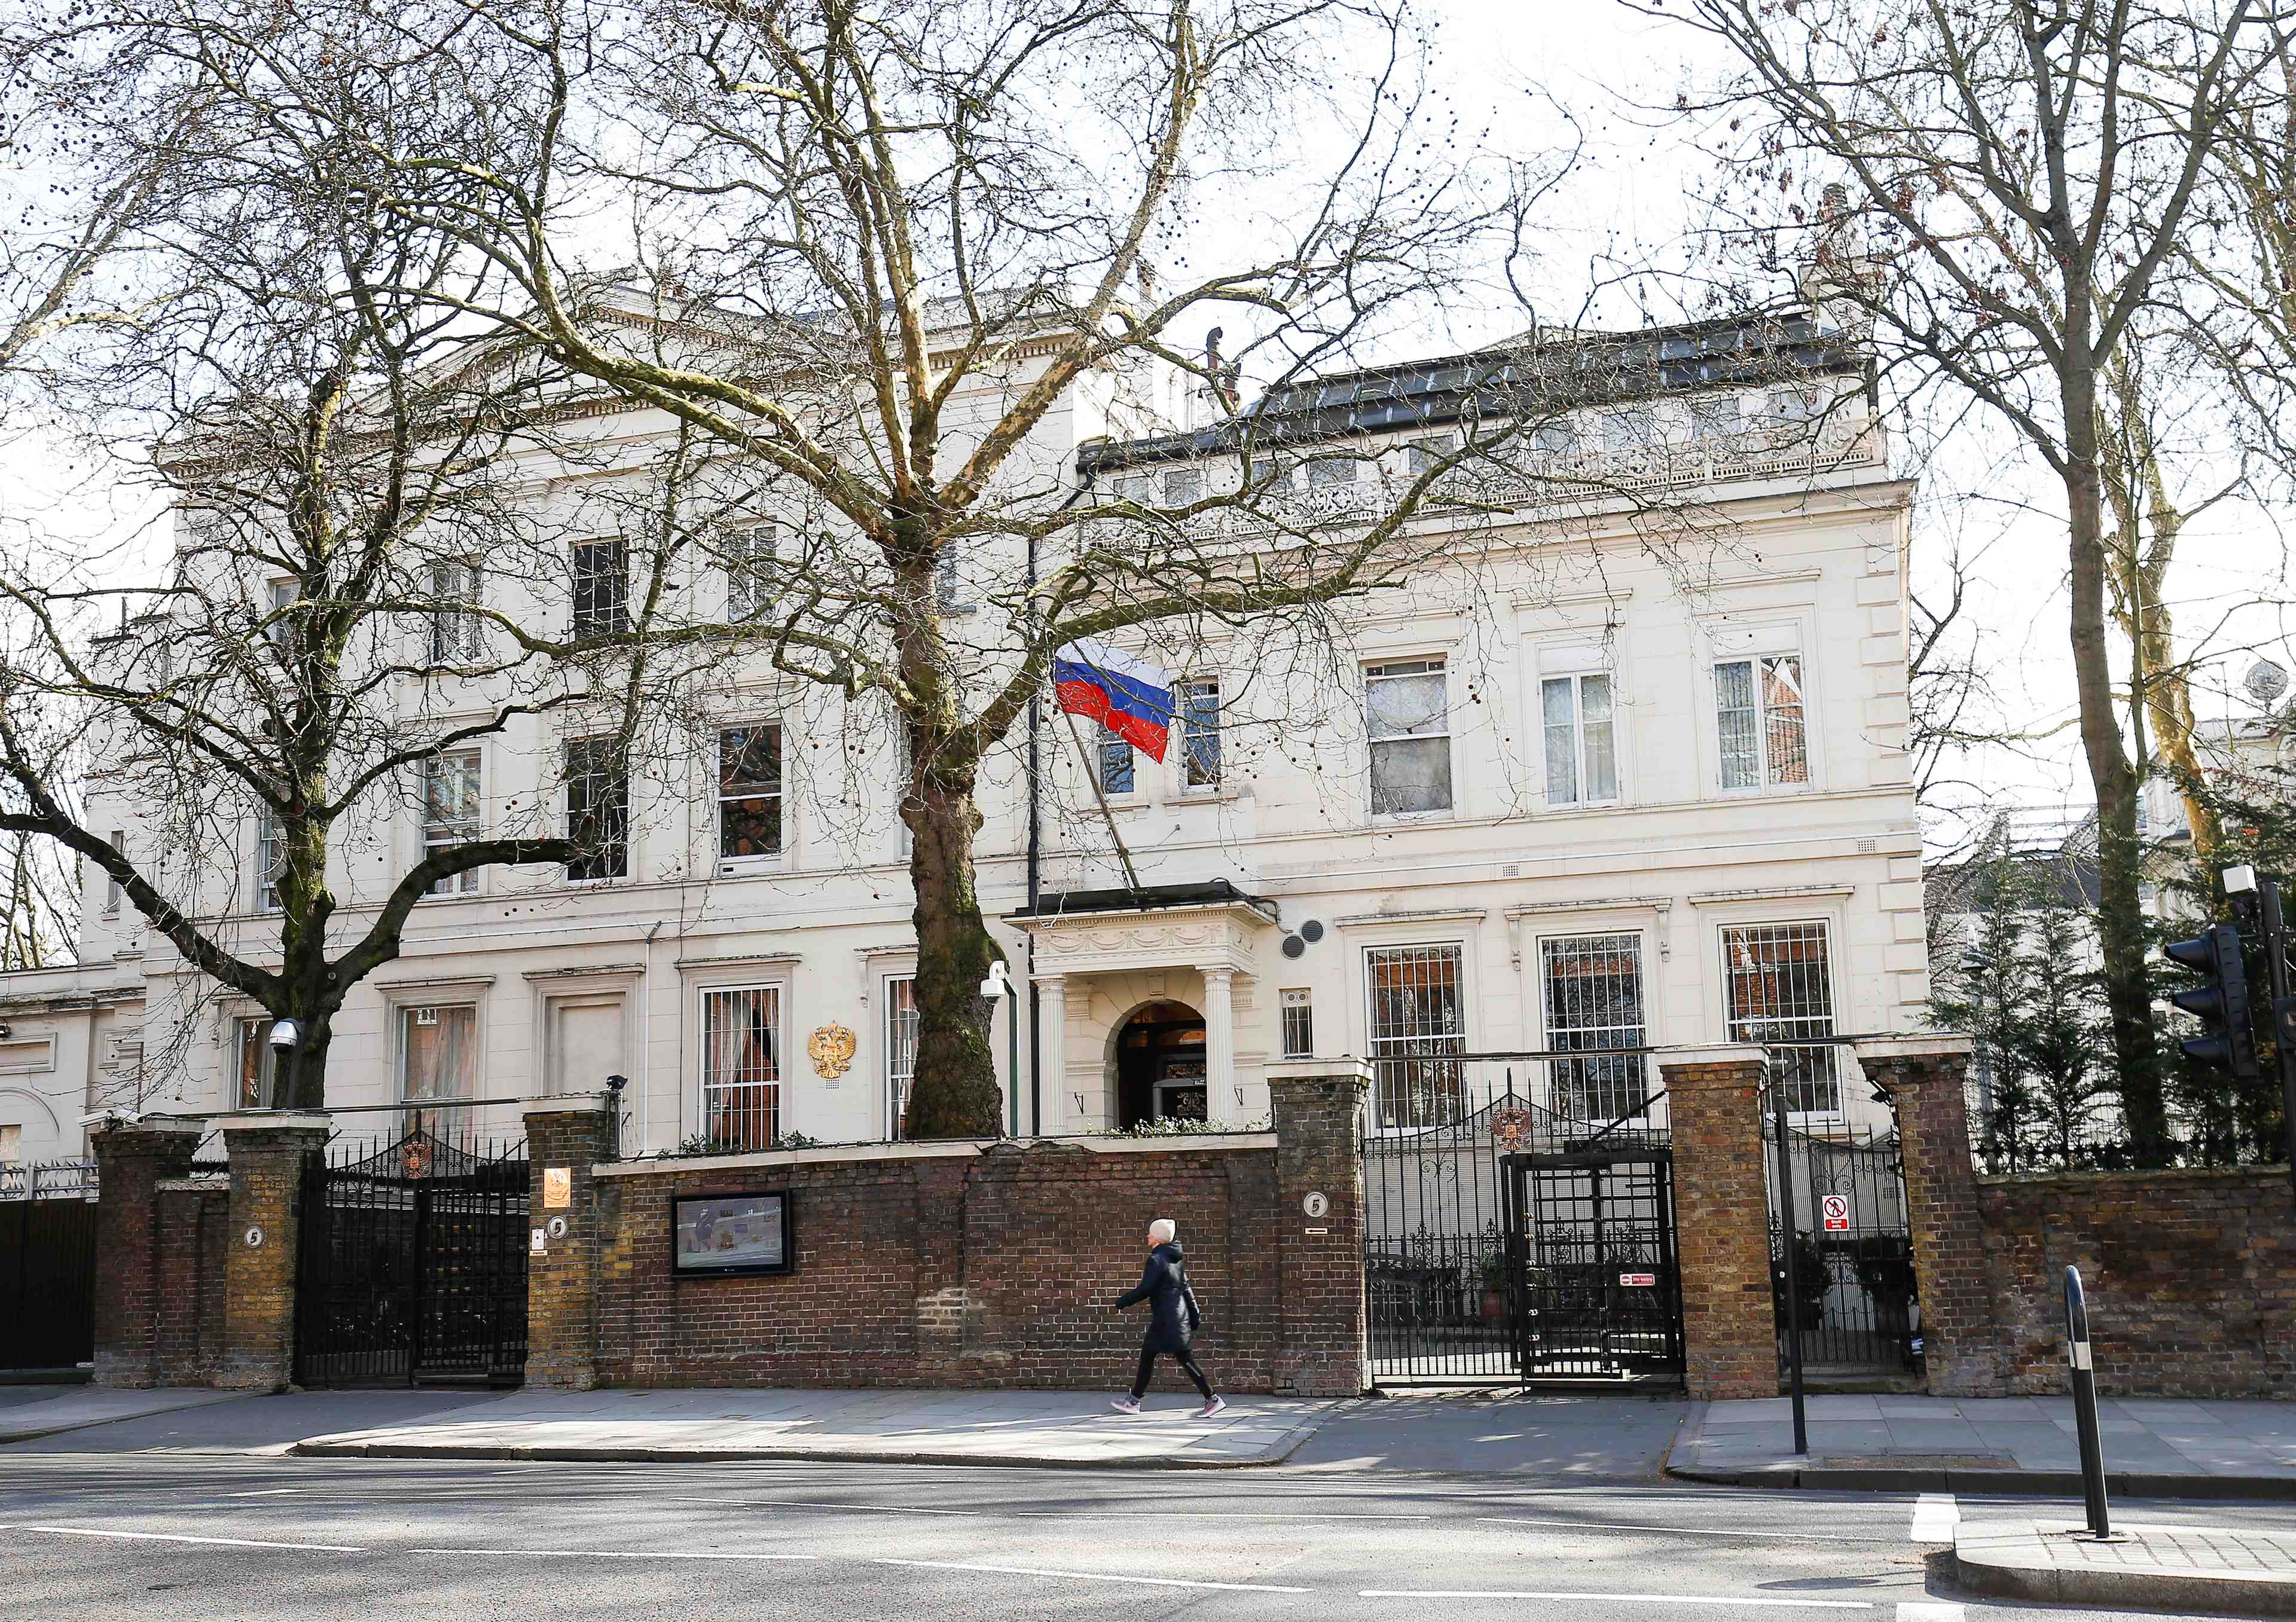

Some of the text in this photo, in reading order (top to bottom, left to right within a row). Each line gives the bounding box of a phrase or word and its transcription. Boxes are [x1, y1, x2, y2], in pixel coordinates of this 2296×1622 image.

[1311, 1199, 1320, 1212] 5
[554, 1222, 561, 1234] 5
[250, 1232, 258, 1244] 5
